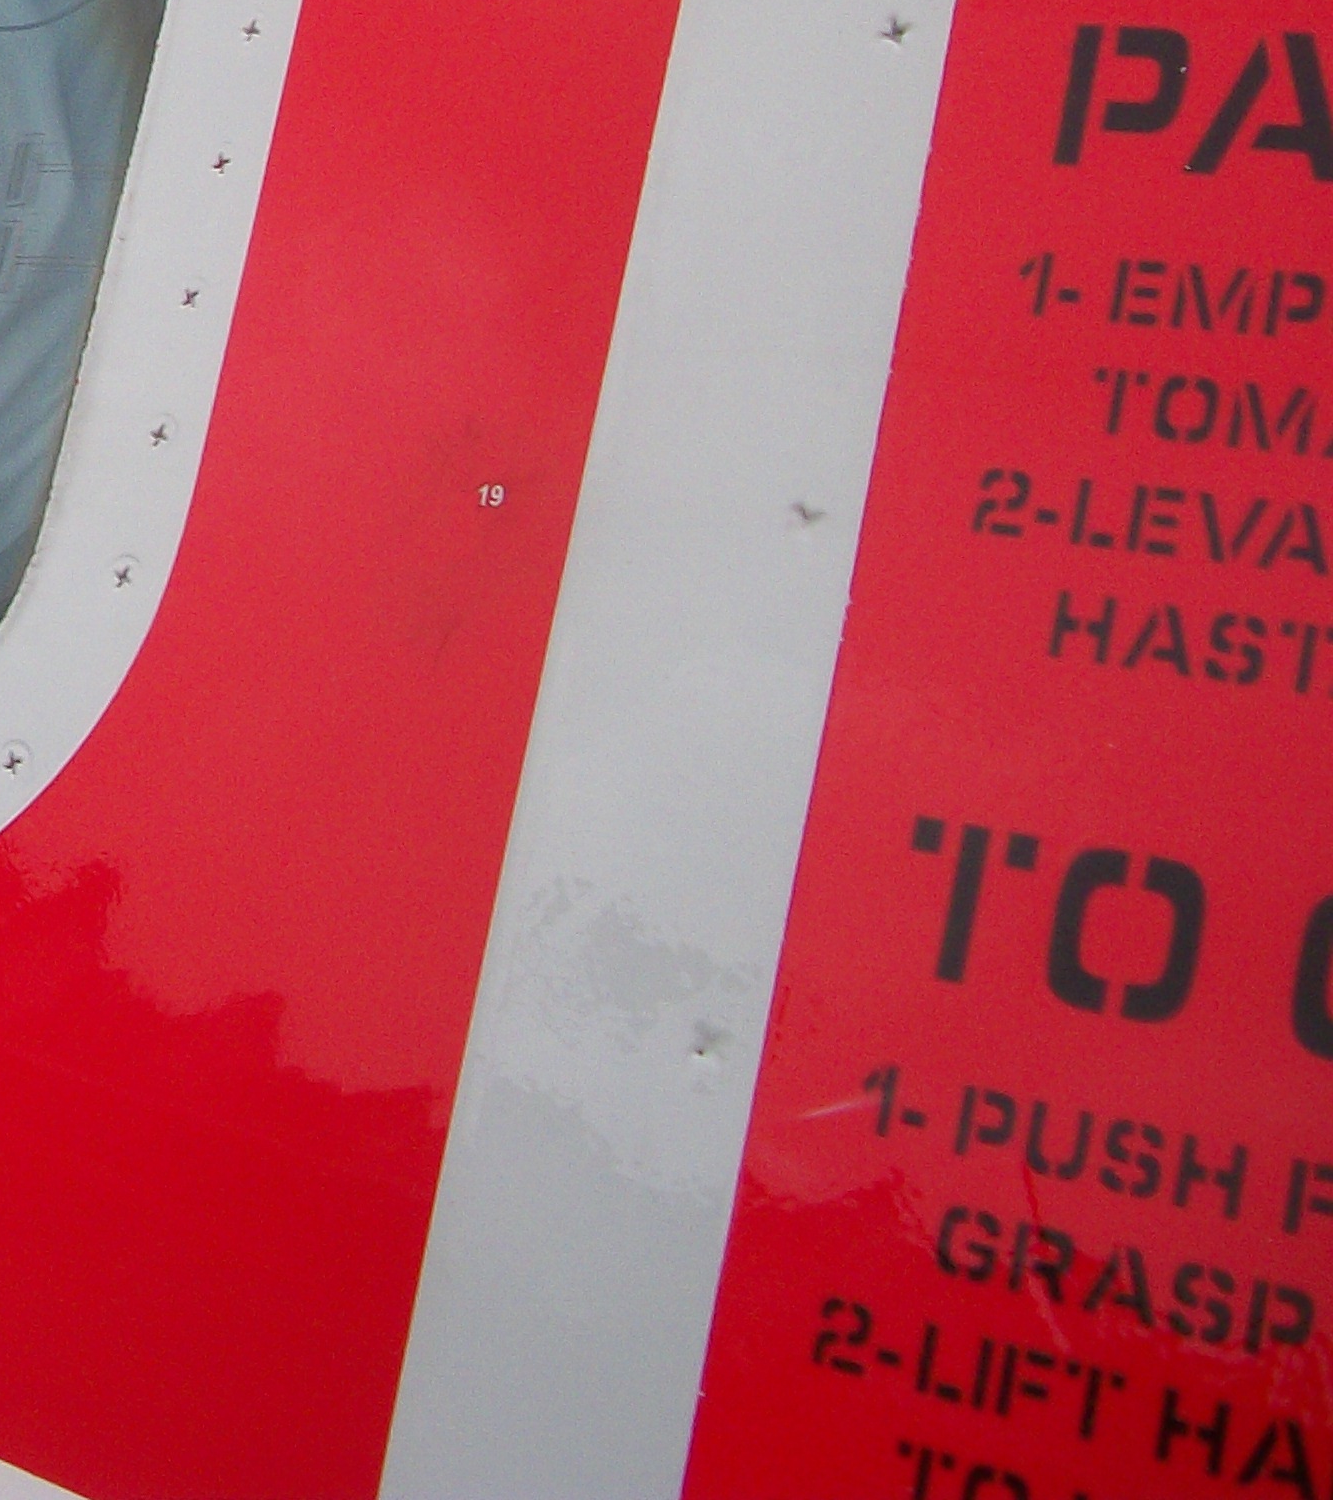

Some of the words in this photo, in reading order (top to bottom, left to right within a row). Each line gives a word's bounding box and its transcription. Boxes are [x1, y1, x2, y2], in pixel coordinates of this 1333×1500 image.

[1053, 24, 1333, 183] PA
[1019, 254, 1081, 317] 1-
[1108, 259, 1326, 337] EMP
[1094, 367, 1333, 458] TOM
[477, 483, 504, 507] 19
[1049, 591, 1333, 695] HAST
[911, 815, 1207, 1024] TO
[863, 1065, 925, 1136] 1-
[953, 1084, 1248, 1220] PUSH
[935, 1204, 1317, 1357] GRASP
[811, 1296, 1128, 1442] 2-LIFT
[1152, 1384, 1323, 1500] HA
